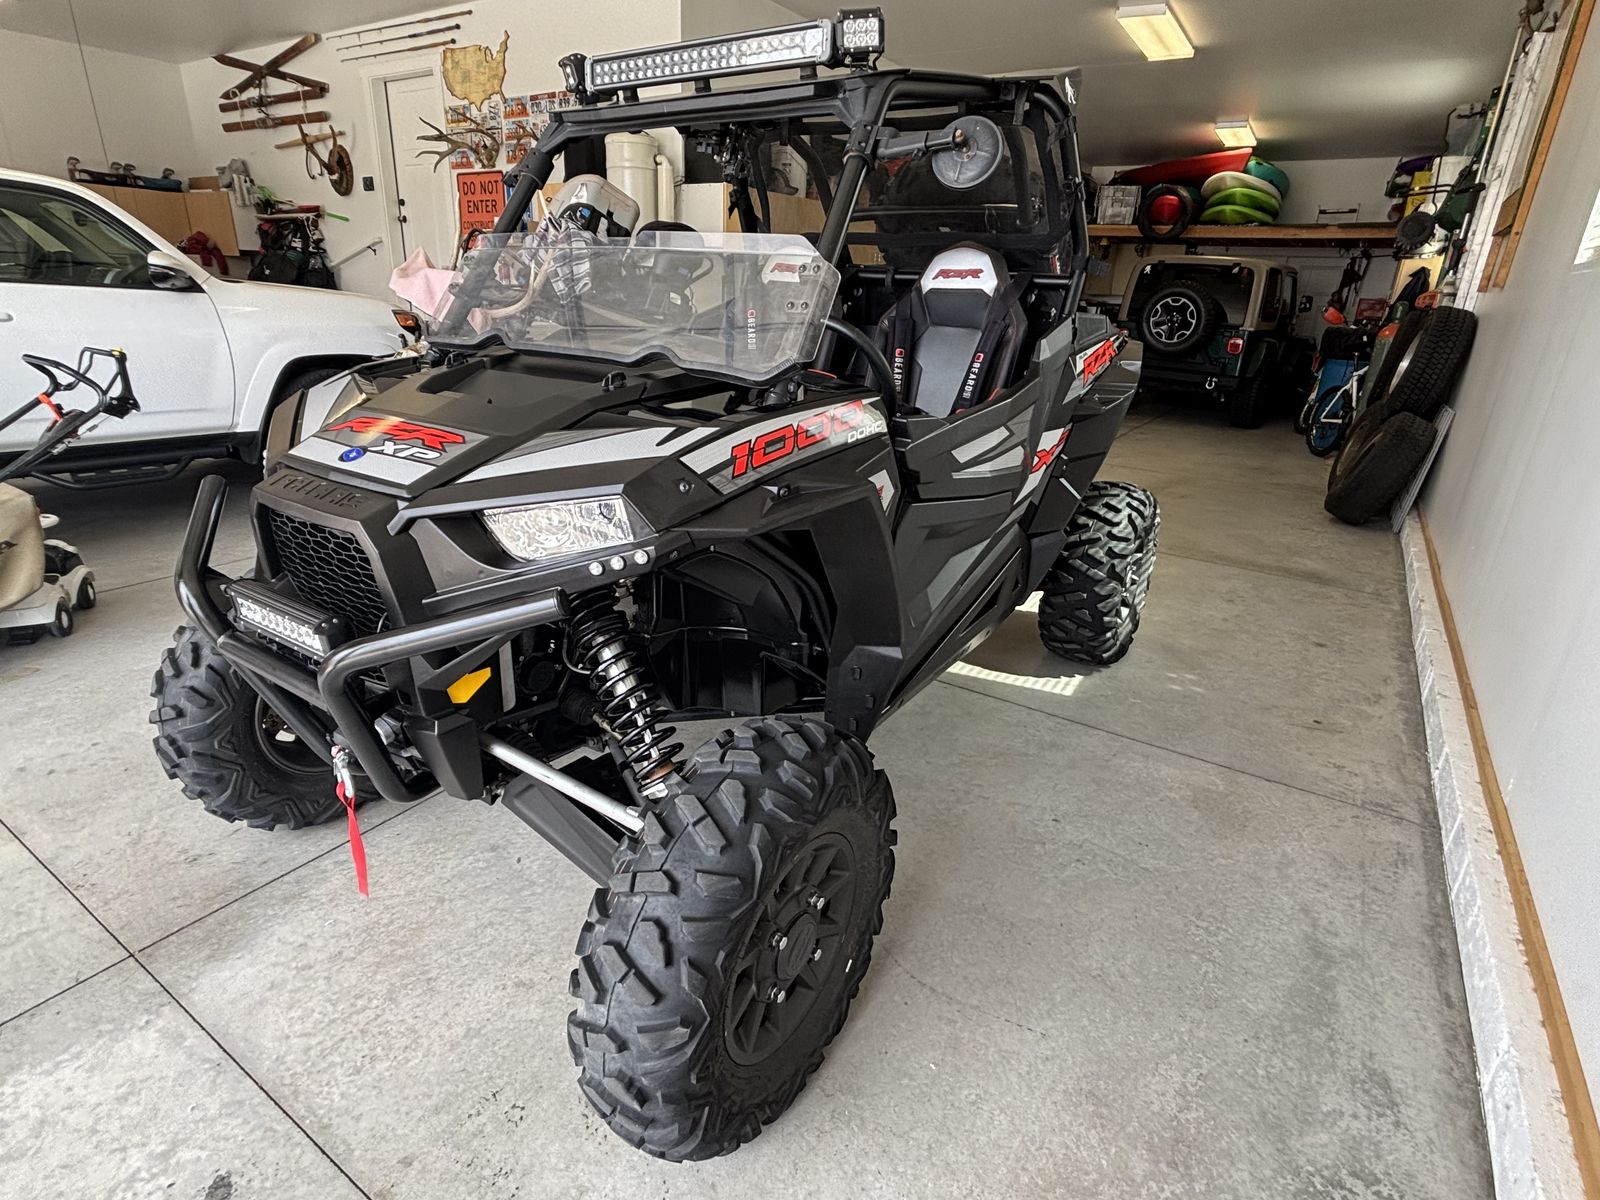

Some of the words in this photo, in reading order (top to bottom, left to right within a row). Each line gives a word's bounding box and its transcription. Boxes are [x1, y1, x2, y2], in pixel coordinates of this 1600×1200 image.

[462, 181, 476, 195] DO
[480, 180, 499, 194] NOT
[467, 199, 498, 214] ENTER
[747, 316, 756, 344] BEARD
[964, 361, 981, 391] BEARD
[321, 416, 466, 452] RZR
[731, 400, 866, 479] 1000
[847, 420, 883, 444] DOHC
[367, 440, 443, 460] XP
